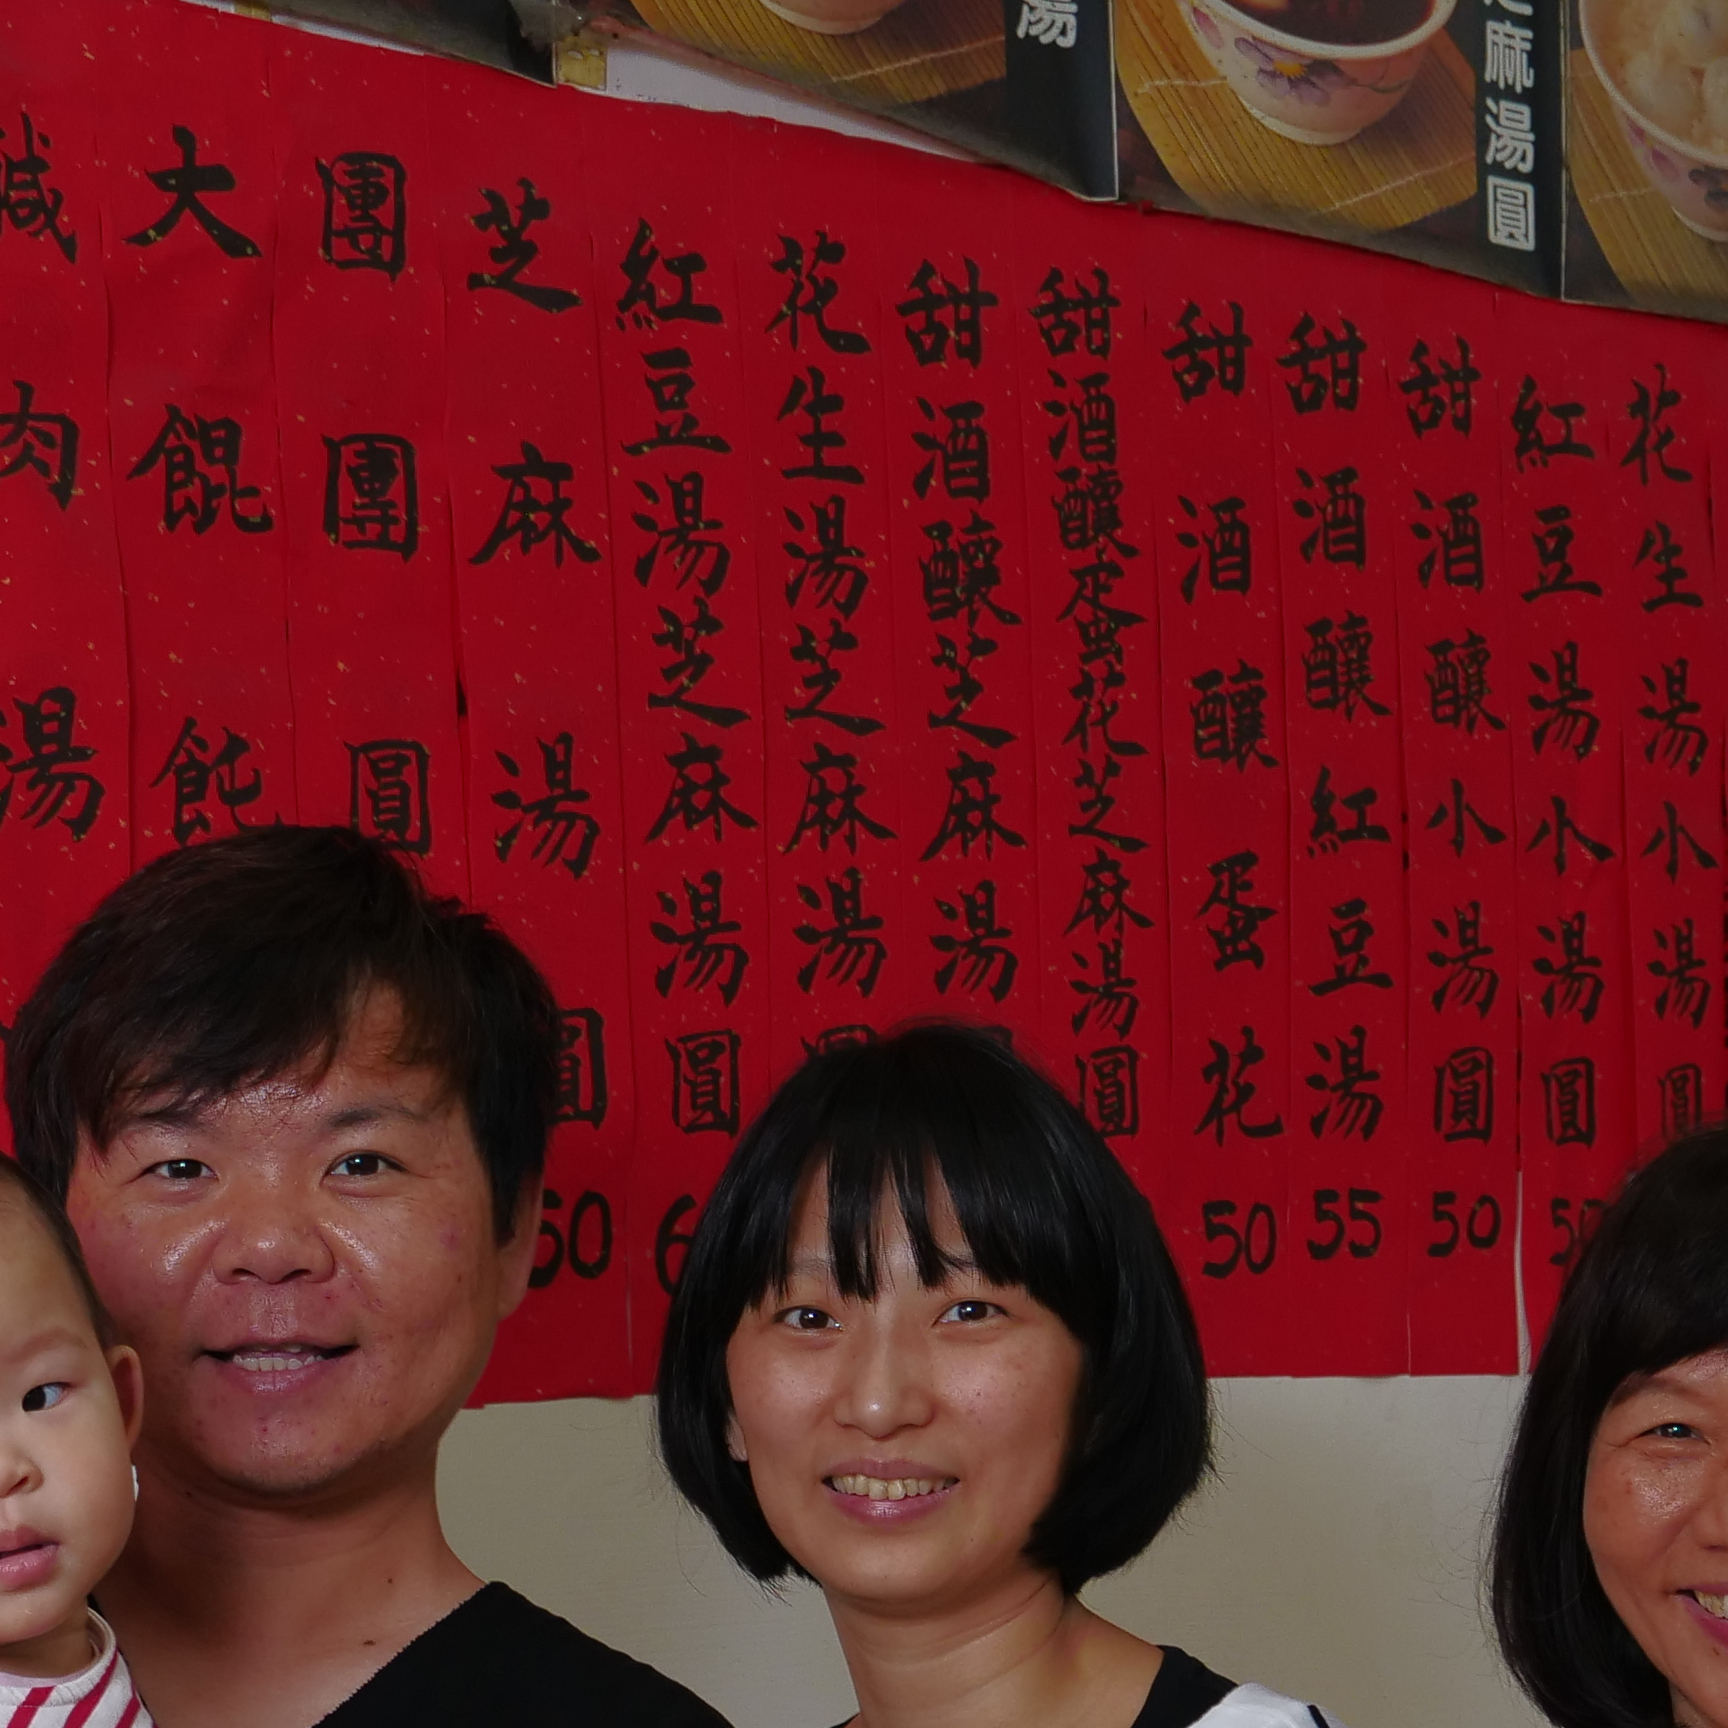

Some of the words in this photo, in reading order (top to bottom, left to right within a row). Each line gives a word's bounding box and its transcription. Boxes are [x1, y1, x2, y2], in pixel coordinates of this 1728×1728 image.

[1482, 0, 1536, 253] 麻湯圓
[619, 218, 756, 1133] 紅豆湯芝麻湯圓
[764, 232, 898, 1050] 花生湯芝麻湯
[897, 256, 1026, 1040] 甜酒釀芝麻湯
[1165, 303, 1282, 1145] 甜酒釀蛋花
[1278, 315, 1391, 1142] 甜酒釀紅豆湯
[1396, 337, 1505, 1146] 甜酒釀小湯圓
[1510, 373, 1613, 1148] 紅豆湯小湯圓
[656, 1195, 697, 1295] 6
[1200, 1198, 1279, 1280] 50
[1306, 1188, 1385, 1261] 55
[1428, 1191, 1501, 1258] 50
